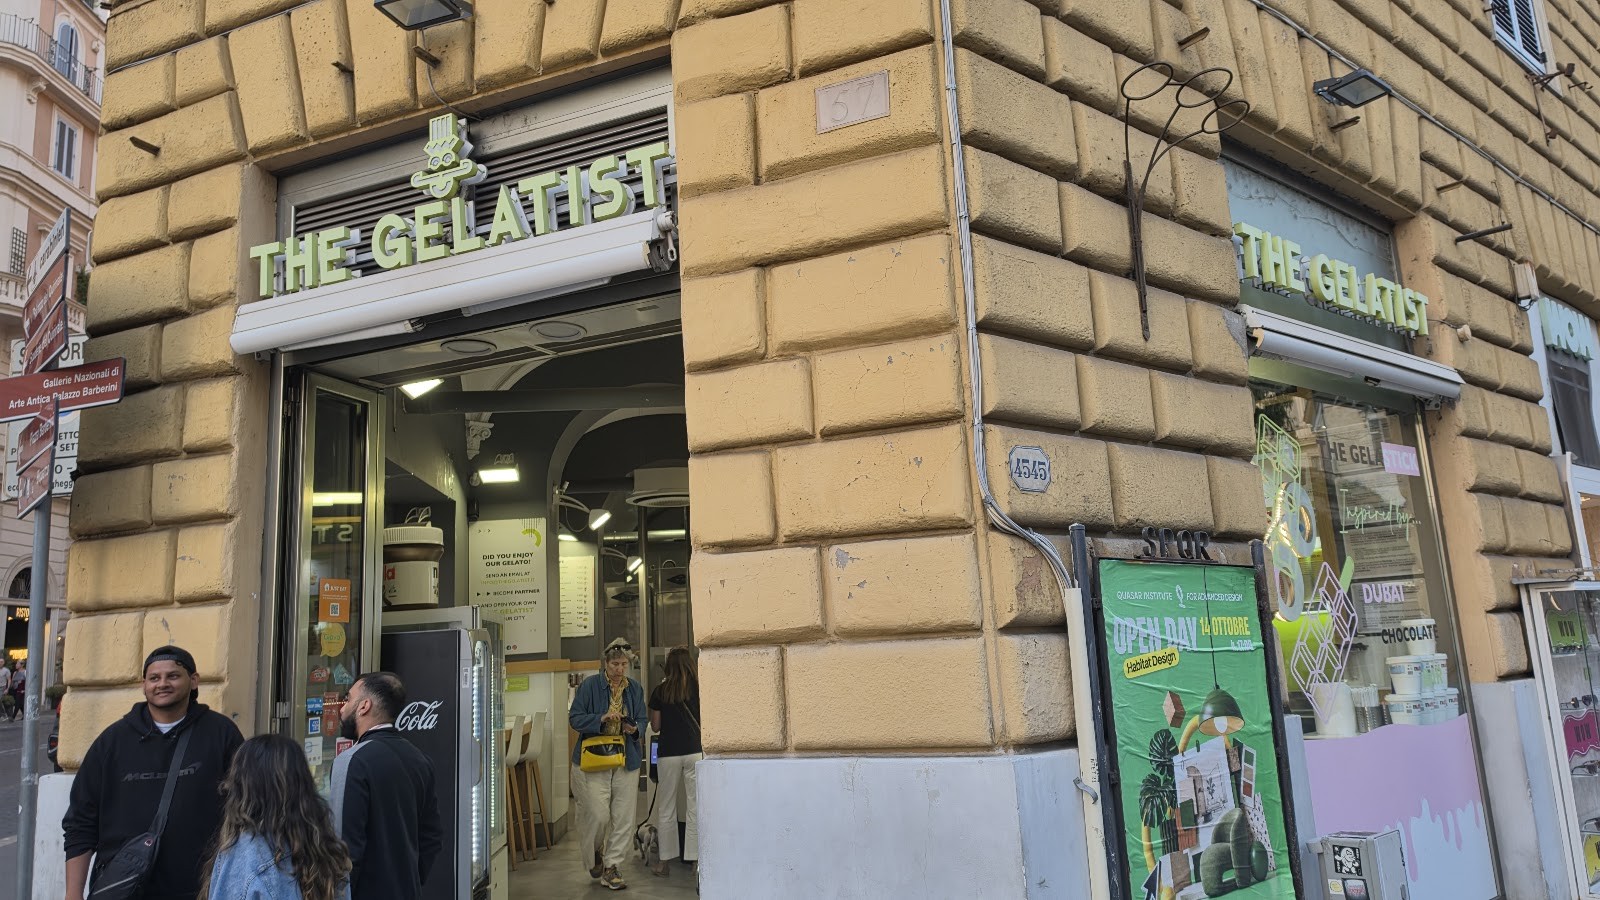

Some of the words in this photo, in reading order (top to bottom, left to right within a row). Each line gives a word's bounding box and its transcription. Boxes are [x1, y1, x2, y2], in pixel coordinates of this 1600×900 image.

[250, 226, 353, 297] THE
[371, 141, 670, 269] GELATIST
[1234, 221, 1305, 294] THE
[1309, 253, 1429, 336] GELATIST
[43, 377, 72, 389] Gallerie
[74, 369, 109, 383] Nazionali
[111, 367, 119, 376] di
[8, 398, 25, 409] Arte
[27, 394, 51, 406] Antica
[82, 382, 118, 396] Barberini
[1014, 458, 1047, 480] 4545
[1383, 449, 1417, 470] STICK
[1340, 488, 1394, 536] Inspired
[1142, 526, 1213, 560] SPQR
[1117, 591, 1143, 600] QUASAR
[1144, 591, 1173, 601] INSTITUTE
[1187, 592, 1198, 601] FOR
[1362, 583, 1405, 604] DUBAI
[1113, 616, 1162, 654] OPEN
[1164, 616, 1198, 651] DAY
[1200, 616, 1211, 636] 14
[1212, 616, 1251, 636] OTTOBRE
[1381, 624, 1439, 645] CHOCOLATE
[1126, 656, 1152, 674] Habitat
[1152, 651, 1177, 667] Design
[395, 700, 444, 731] Cola
